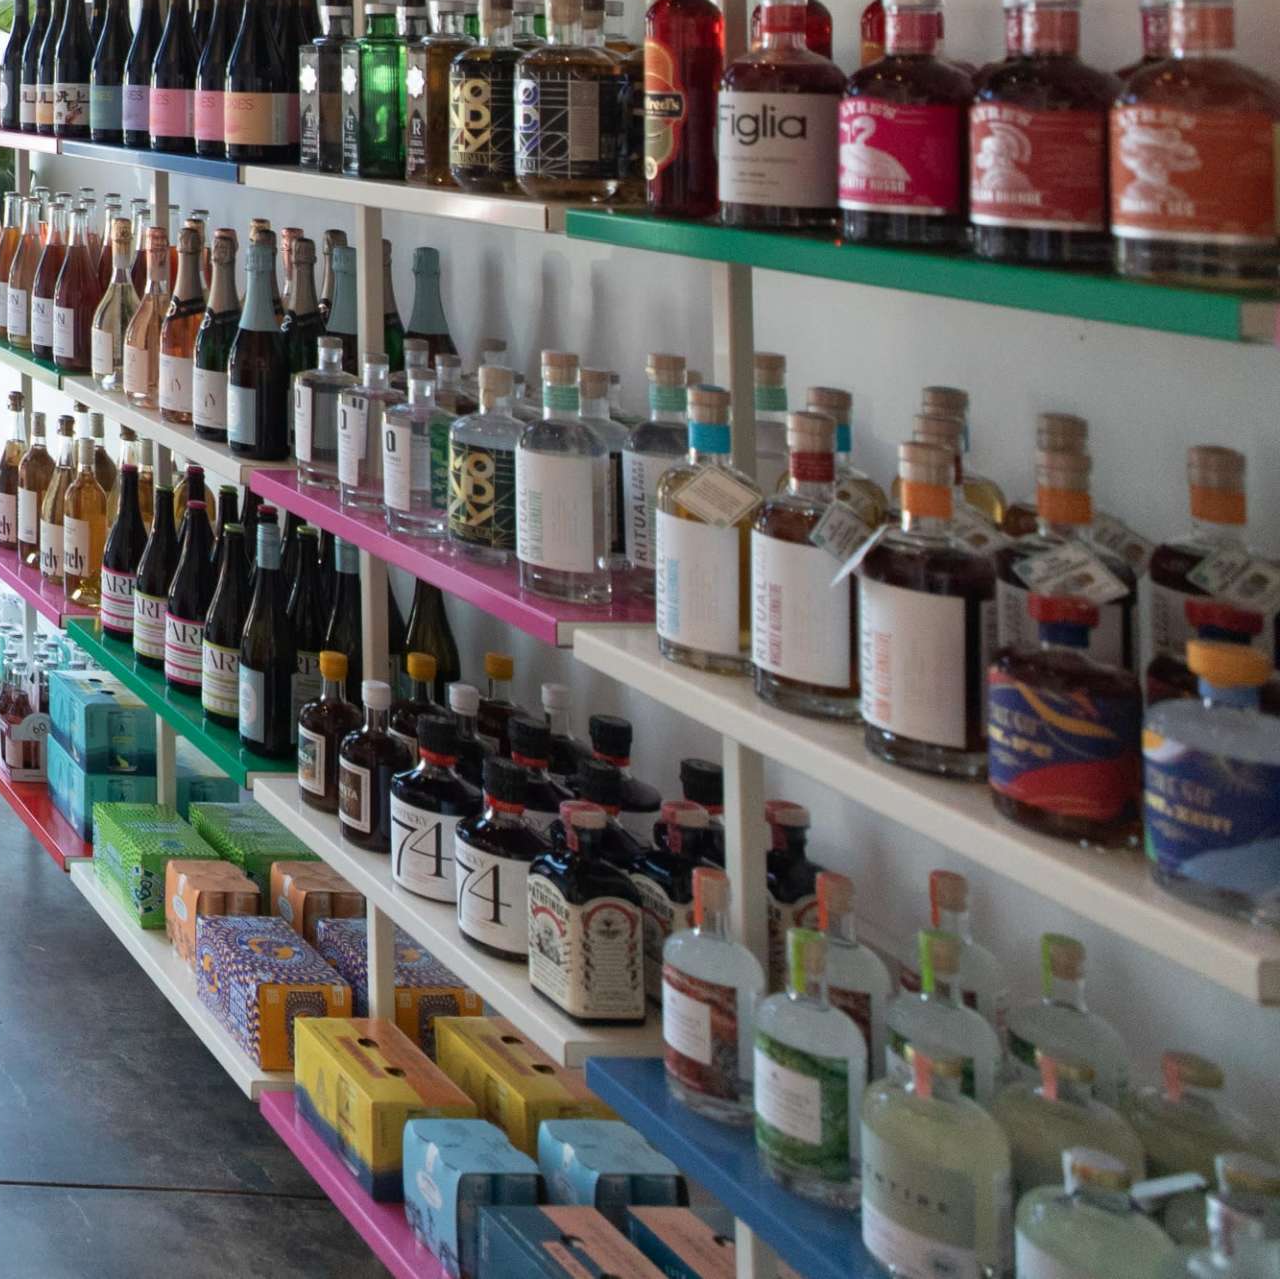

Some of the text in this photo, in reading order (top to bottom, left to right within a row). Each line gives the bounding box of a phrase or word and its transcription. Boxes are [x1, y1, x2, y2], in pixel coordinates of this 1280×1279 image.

[719, 104, 808, 147] Figlia
[633, 492, 648, 562] RITUAL
[391, 815, 455, 880] 74
[455, 857, 513, 927] 74
